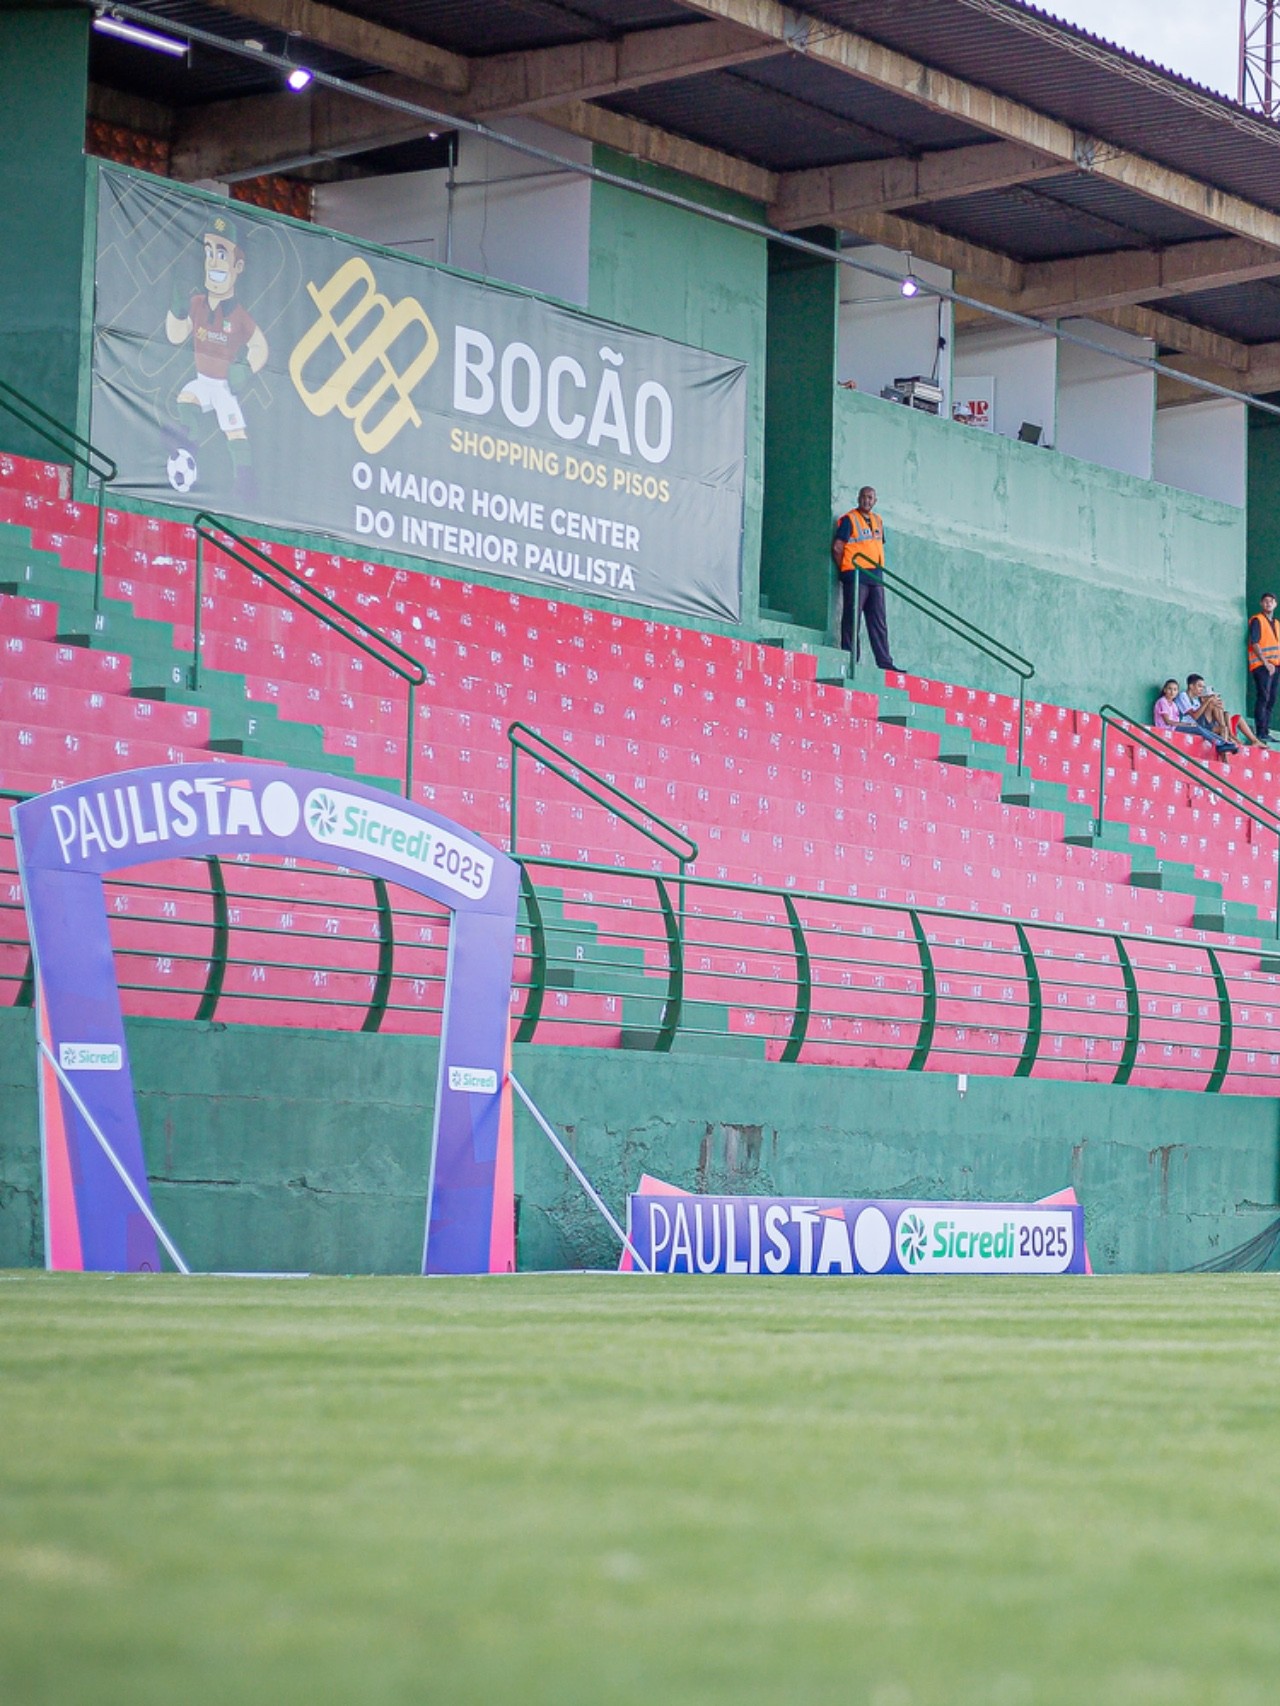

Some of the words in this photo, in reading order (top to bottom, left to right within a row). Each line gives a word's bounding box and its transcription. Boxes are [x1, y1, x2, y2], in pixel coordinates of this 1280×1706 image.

[454, 325, 673, 463] BOCÃO
[352, 461, 372, 490] O
[380, 467, 465, 513] MAIOR
[472, 489, 544, 530] HOME
[550, 508, 640, 551] CENTER
[450, 428, 559, 475] SHOPPING
[565, 456, 607, 488] DOS
[613, 469, 670, 502] PISOS
[356, 505, 395, 538] DO
[402, 516, 518, 567] INTERIOR
[525, 543, 636, 591] PAULISTA
[50, 778, 300, 864] PAULISTÃO
[342, 806, 433, 862] Sicredi
[433, 842, 485, 889] 2025
[78, 1050, 119, 1065] Sicredi
[650, 1202, 891, 1274] PAULISTÃO
[931, 1220, 1014, 1258] Sicredi
[1019, 1226, 1068, 1257] 2025
